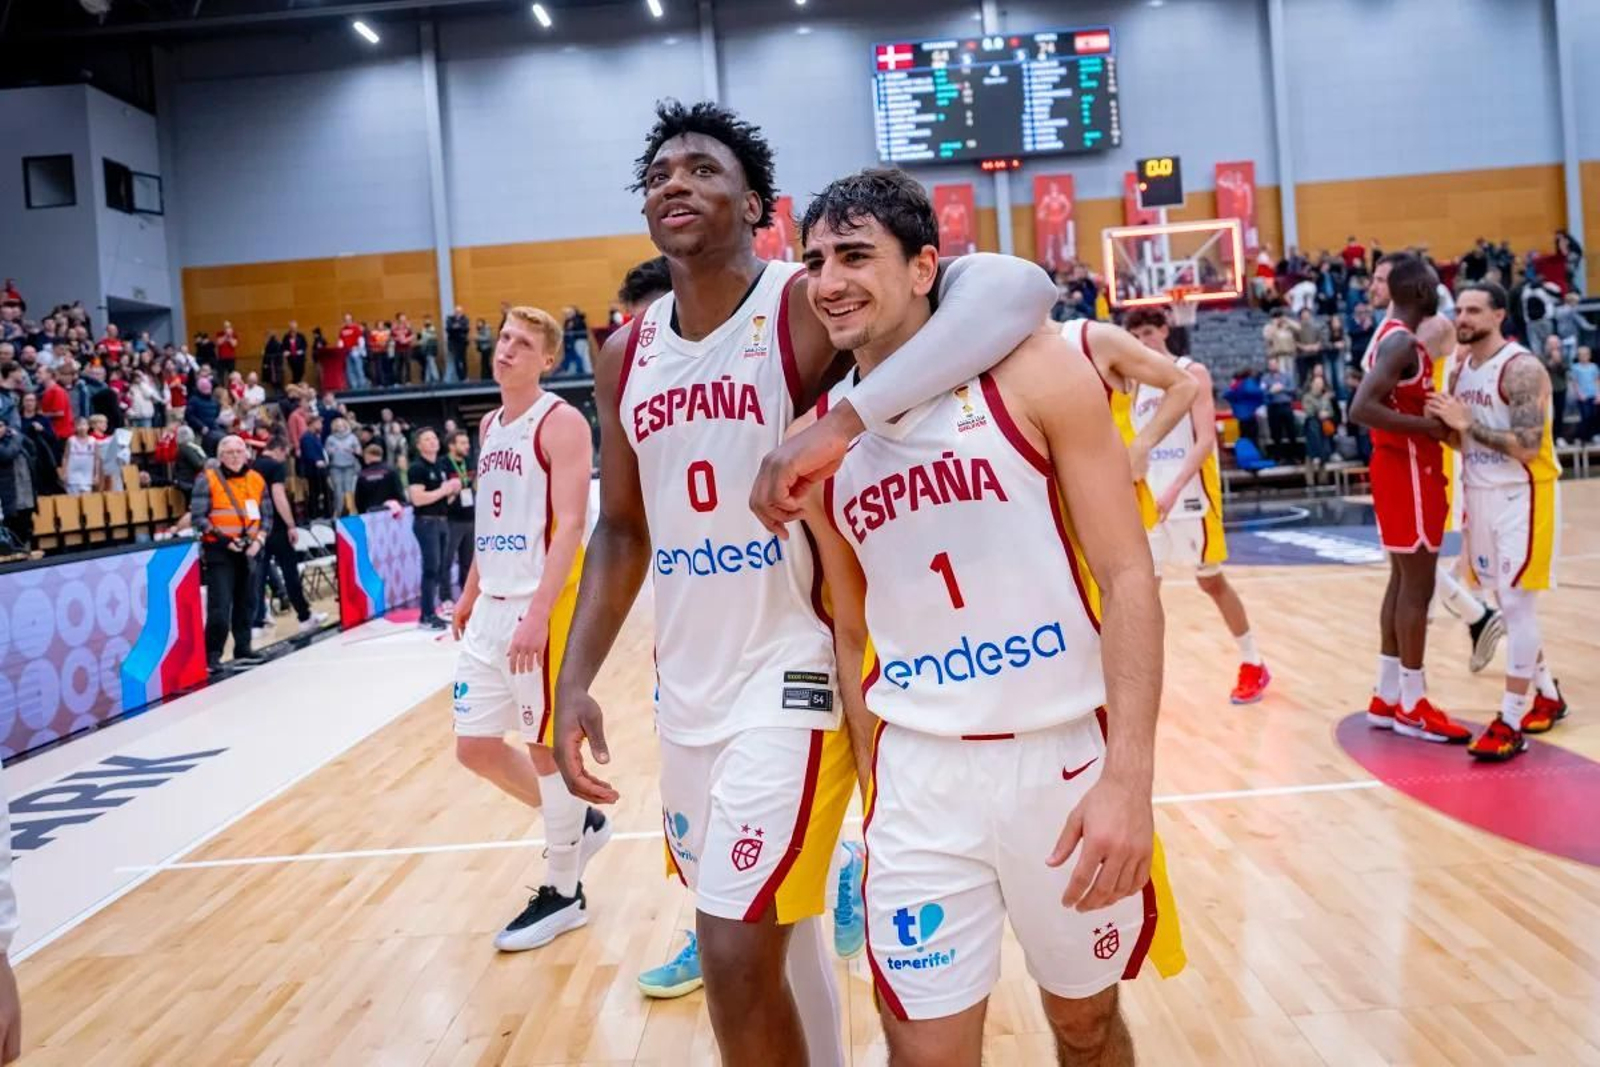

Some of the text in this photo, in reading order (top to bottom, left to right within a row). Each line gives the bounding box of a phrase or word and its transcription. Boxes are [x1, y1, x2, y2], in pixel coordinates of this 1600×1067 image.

[633, 375, 765, 441] ESPAÑA
[492, 490, 502, 517] 9
[687, 460, 718, 512] 0
[843, 451, 1009, 545] ESPAÑA
[656, 535, 782, 576] endesa
[929, 551, 965, 610] 1
[883, 622, 1066, 690] endesa
[9, 746, 231, 862] ARK
